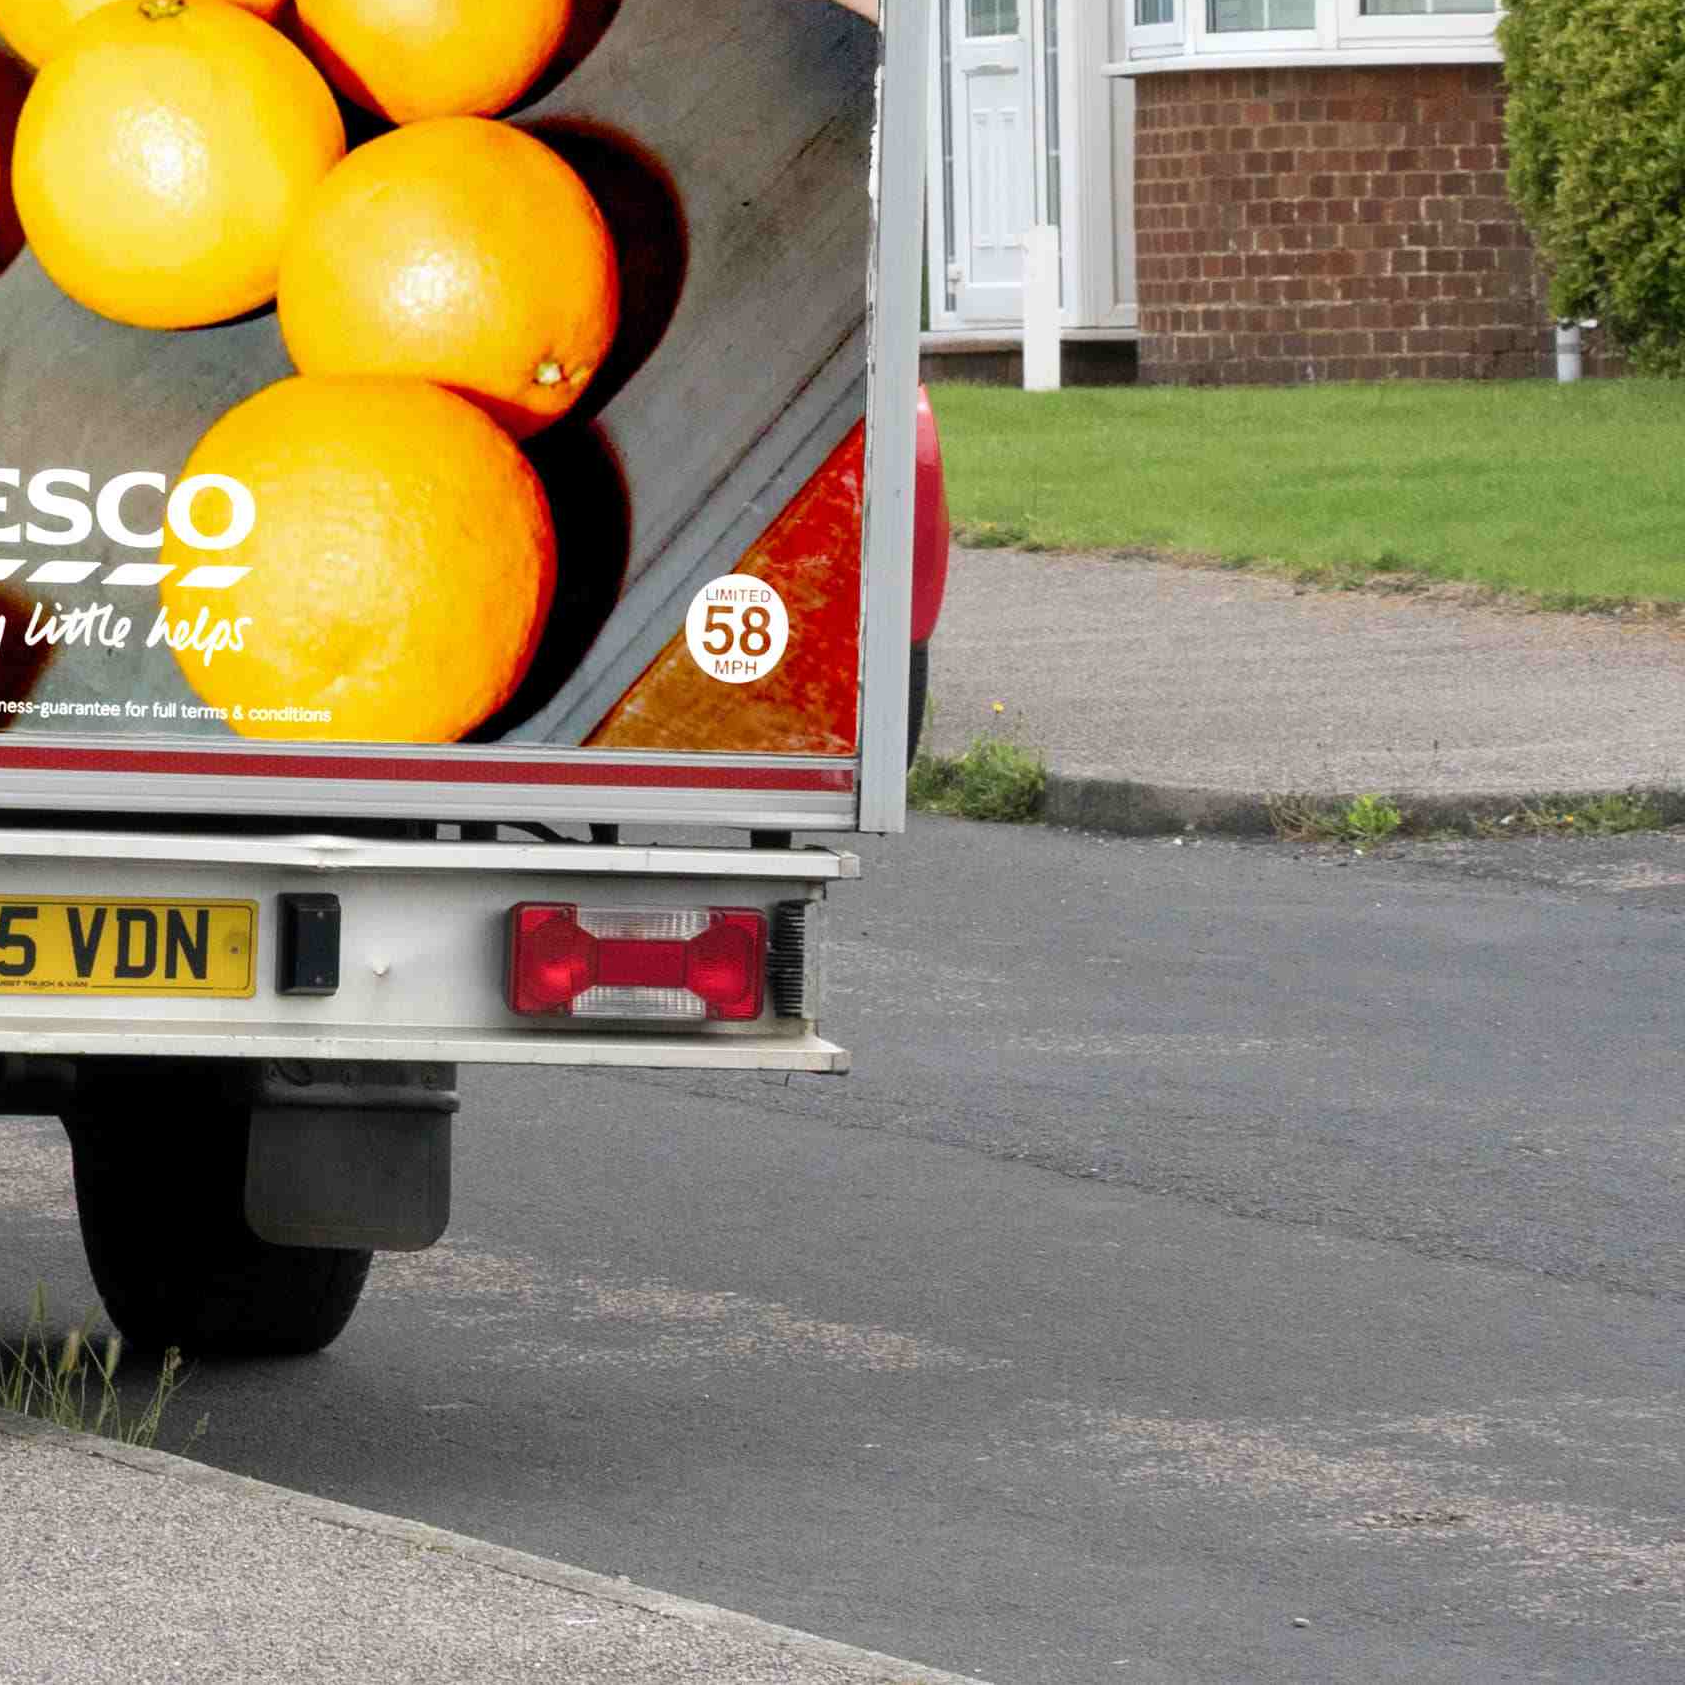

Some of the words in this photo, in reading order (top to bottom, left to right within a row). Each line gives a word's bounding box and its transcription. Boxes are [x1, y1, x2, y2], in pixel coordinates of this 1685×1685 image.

[704, 588, 772, 603] LIMITED
[24, 600, 132, 649] little
[145, 605, 253, 667] helps
[701, 604, 772, 657] 58
[713, 660, 758, 675] MPH
[124, 701, 149, 717] for
[152, 701, 177, 718] full
[180, 703, 229, 720] terms
[232, 705, 245, 721] &
[248, 705, 333, 723] conditions
[66, 905, 211, 981] VDN
